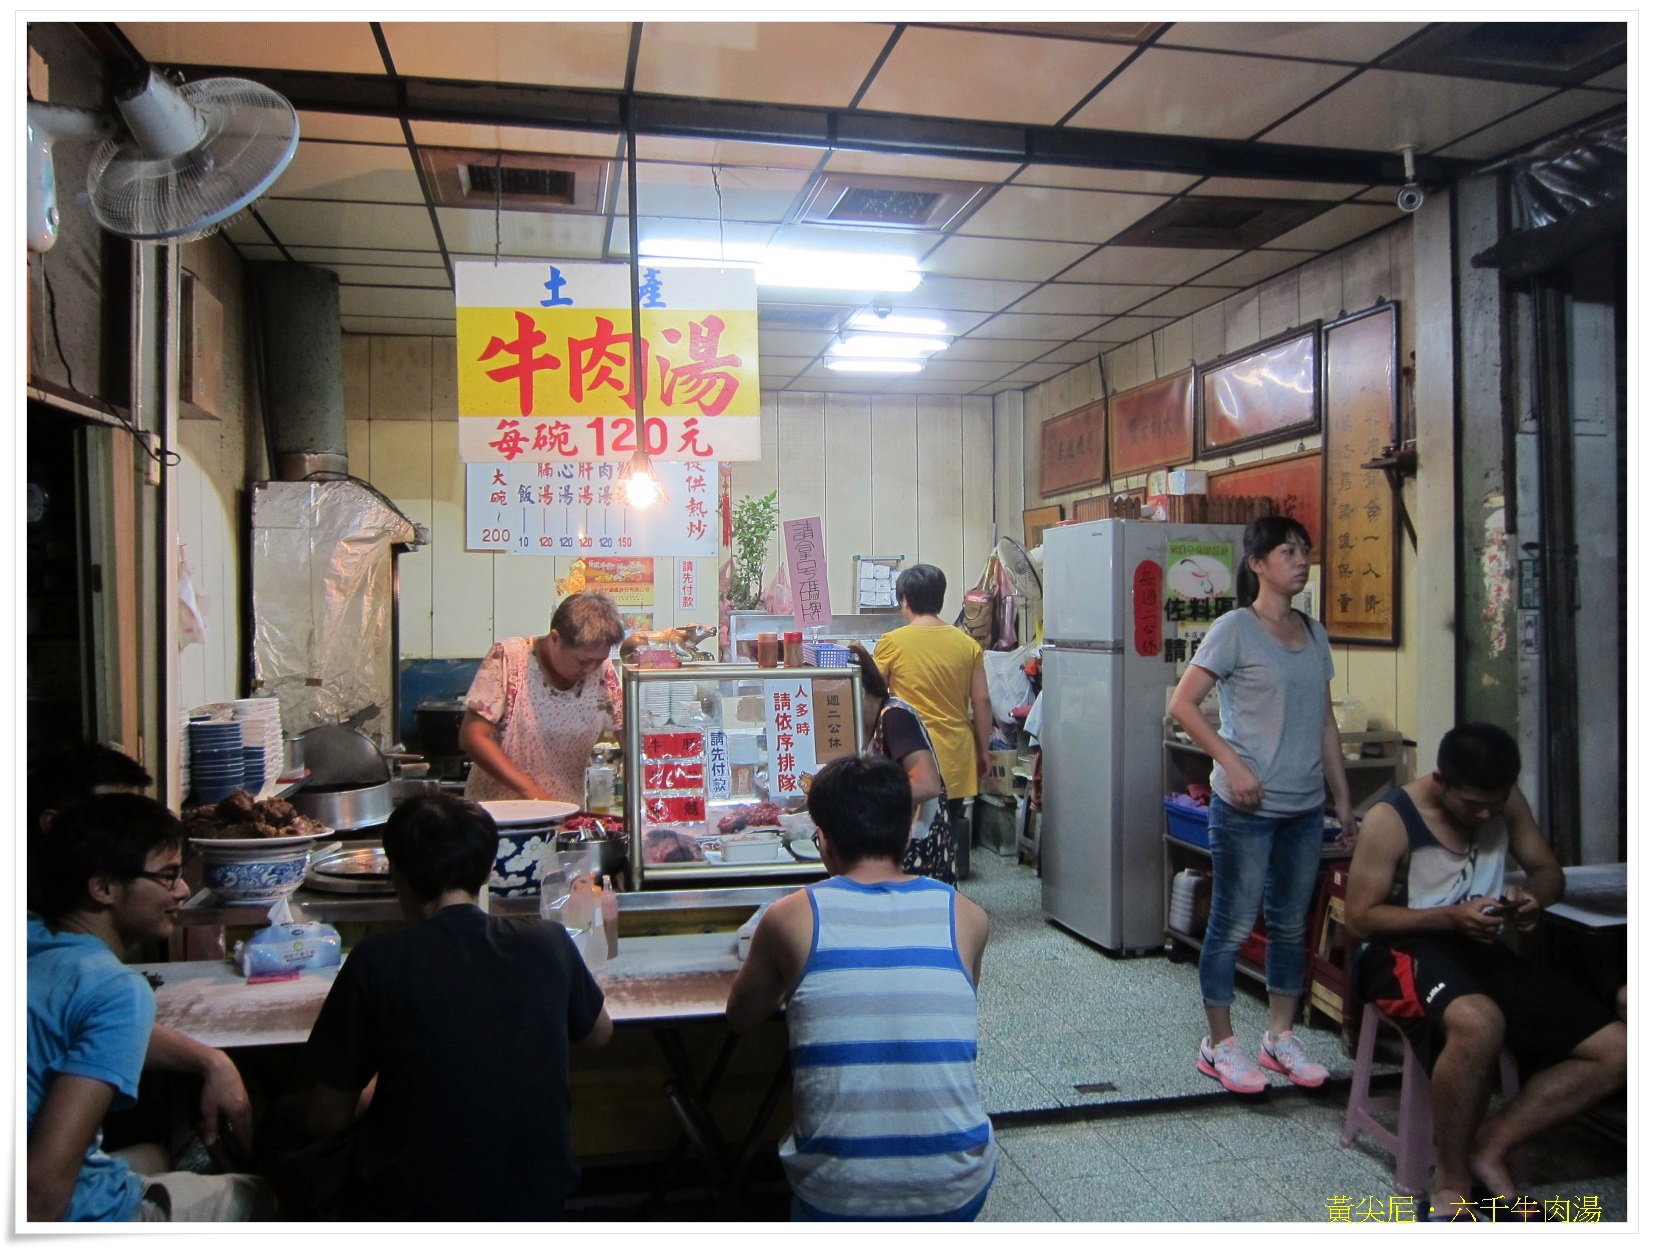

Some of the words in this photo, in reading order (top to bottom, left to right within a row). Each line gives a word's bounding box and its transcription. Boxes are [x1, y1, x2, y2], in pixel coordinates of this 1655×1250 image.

[477, 311, 742, 417] 牛肉湯
[488, 417, 713, 460] 每碗120元
[517, 484, 535, 504] 飯
[482, 529, 510, 542] 200
[519, 537, 529, 547] 10
[539, 537, 553, 547] 120
[559, 537, 573, 547] 120
[579, 537, 593, 547] 120
[599, 537, 613, 548] 120
[618, 537, 632, 547] 150
[682, 560, 694, 608] 請先付款
[795, 684, 810, 736] 人多時
[826, 695, 842, 749] 週二公休
[773, 692, 797, 792] 請依序排隊
[710, 731, 726, 793] 請先付款
